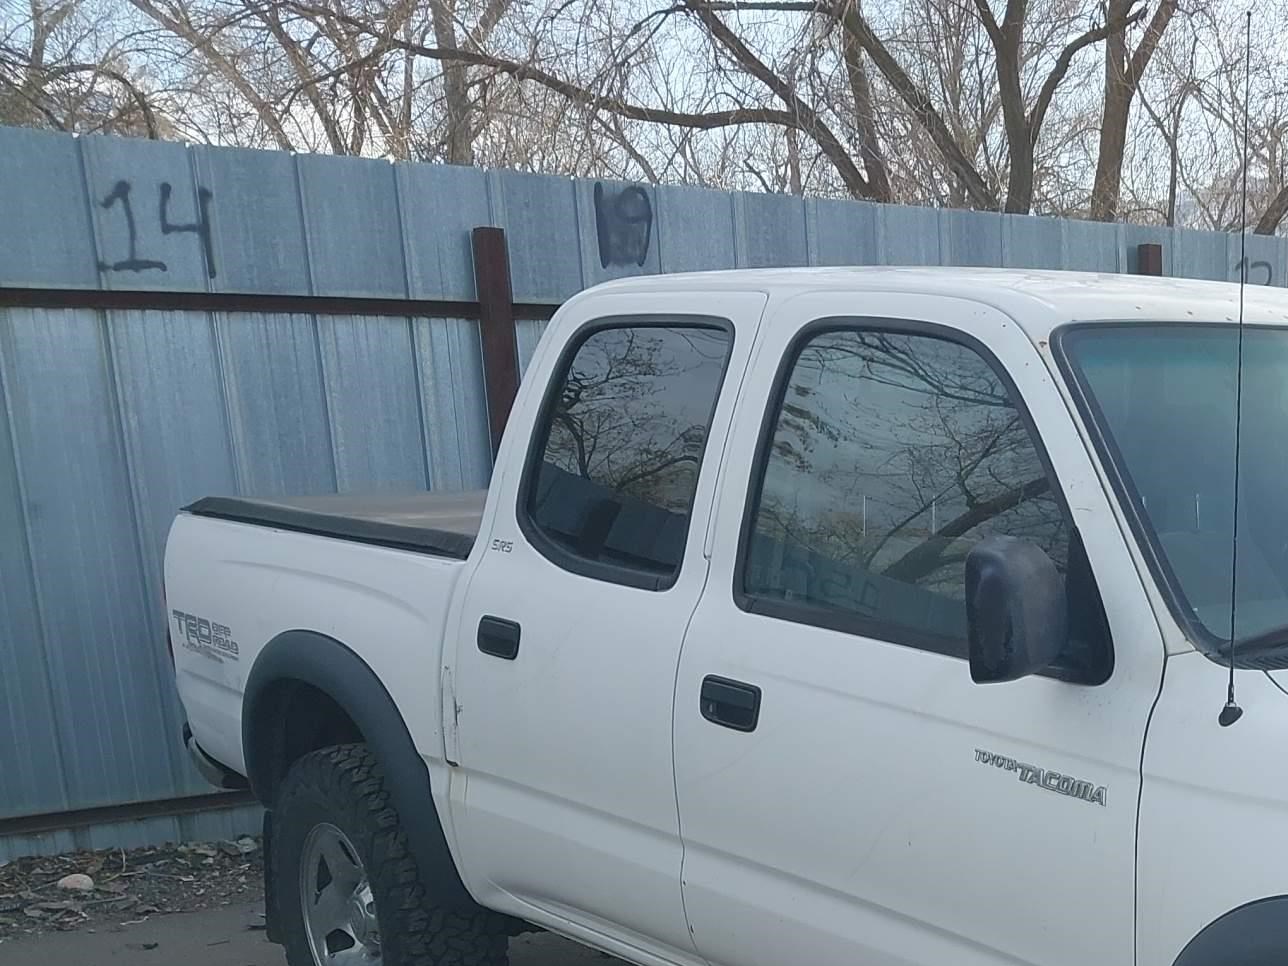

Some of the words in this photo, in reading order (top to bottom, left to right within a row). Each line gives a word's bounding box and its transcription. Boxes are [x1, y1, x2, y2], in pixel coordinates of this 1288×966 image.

[97, 180, 217, 279] 14
[172, 609, 212, 645] TRD
[212, 634, 240, 655] ROAD
[974, 748, 1018, 772] TOYOTA
[1018, 762, 1107, 807] TACOMA
